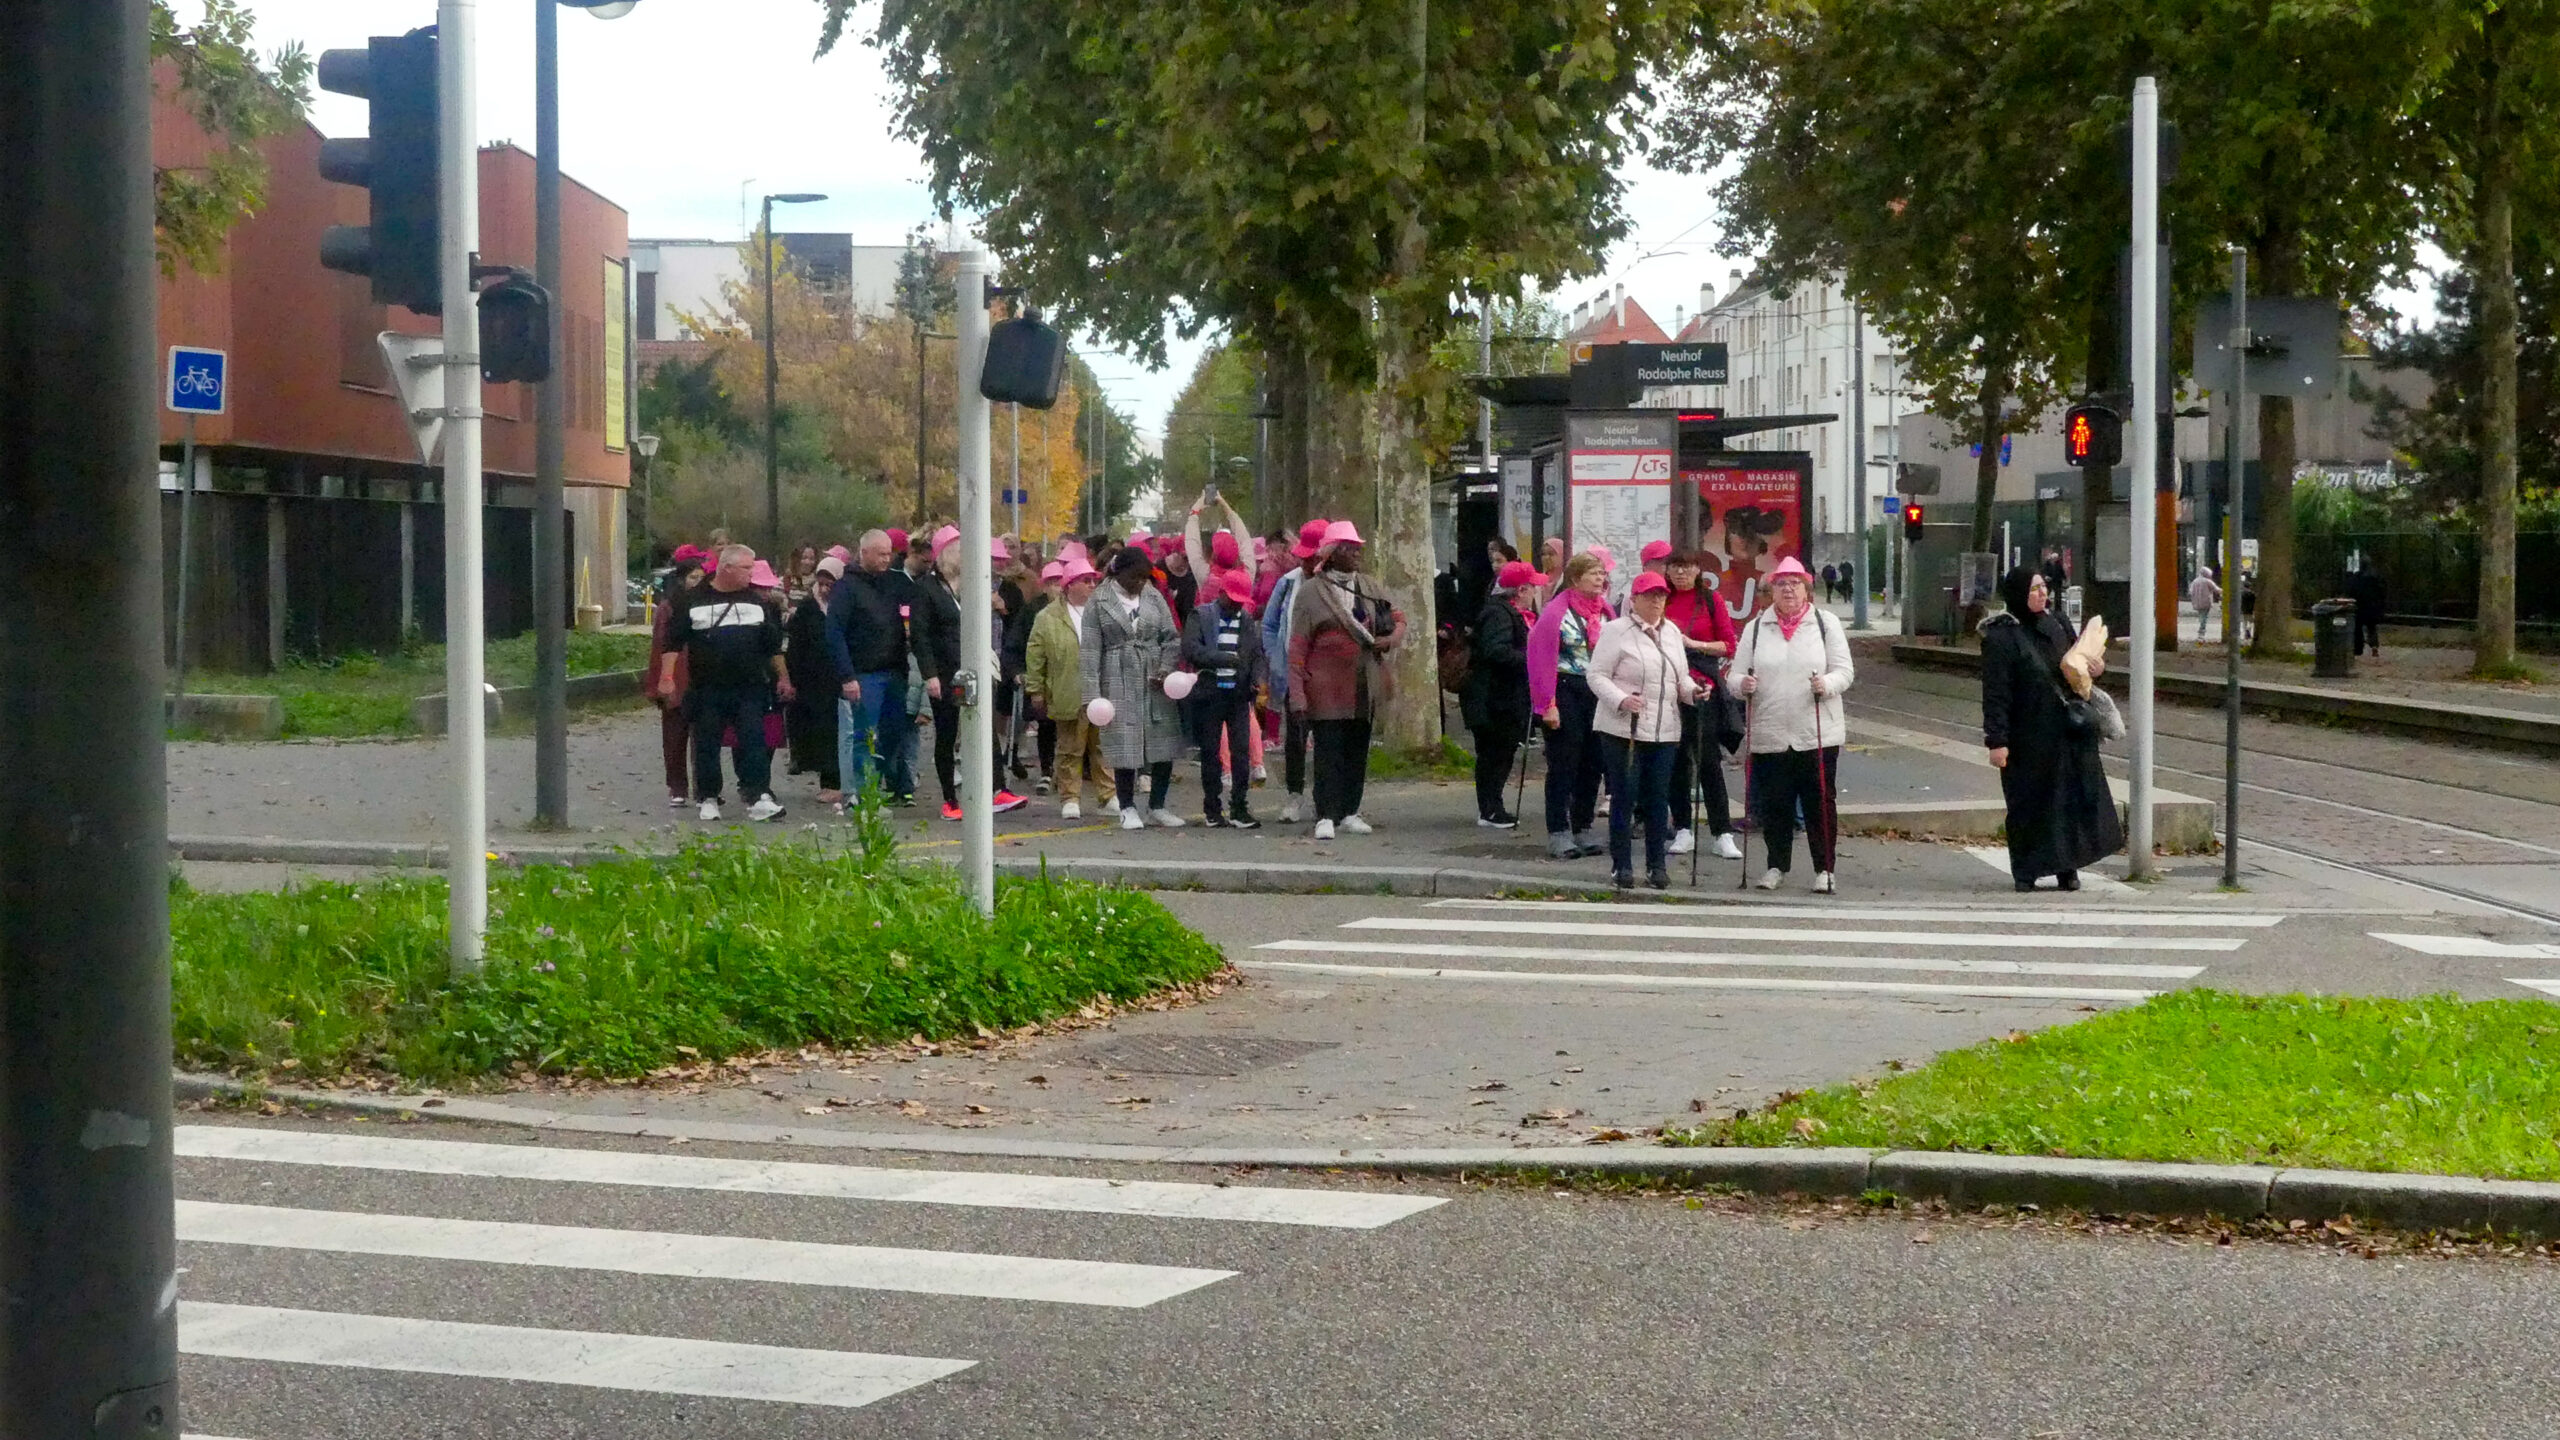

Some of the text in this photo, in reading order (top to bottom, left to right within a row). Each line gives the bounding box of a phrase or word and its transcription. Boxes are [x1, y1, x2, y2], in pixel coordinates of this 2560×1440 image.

[1661, 349, 1702, 362] Neuhof
[1638, 367, 1726, 382] Rodolphe Reuss
[1604, 425, 1639, 435] Neuhof
[1584, 436, 1658, 447] Rodolphe Reuss
[1688, 473, 1796, 481] GRAND MAGASIN
[1711, 483, 1796, 491] EXPLORATEURS
